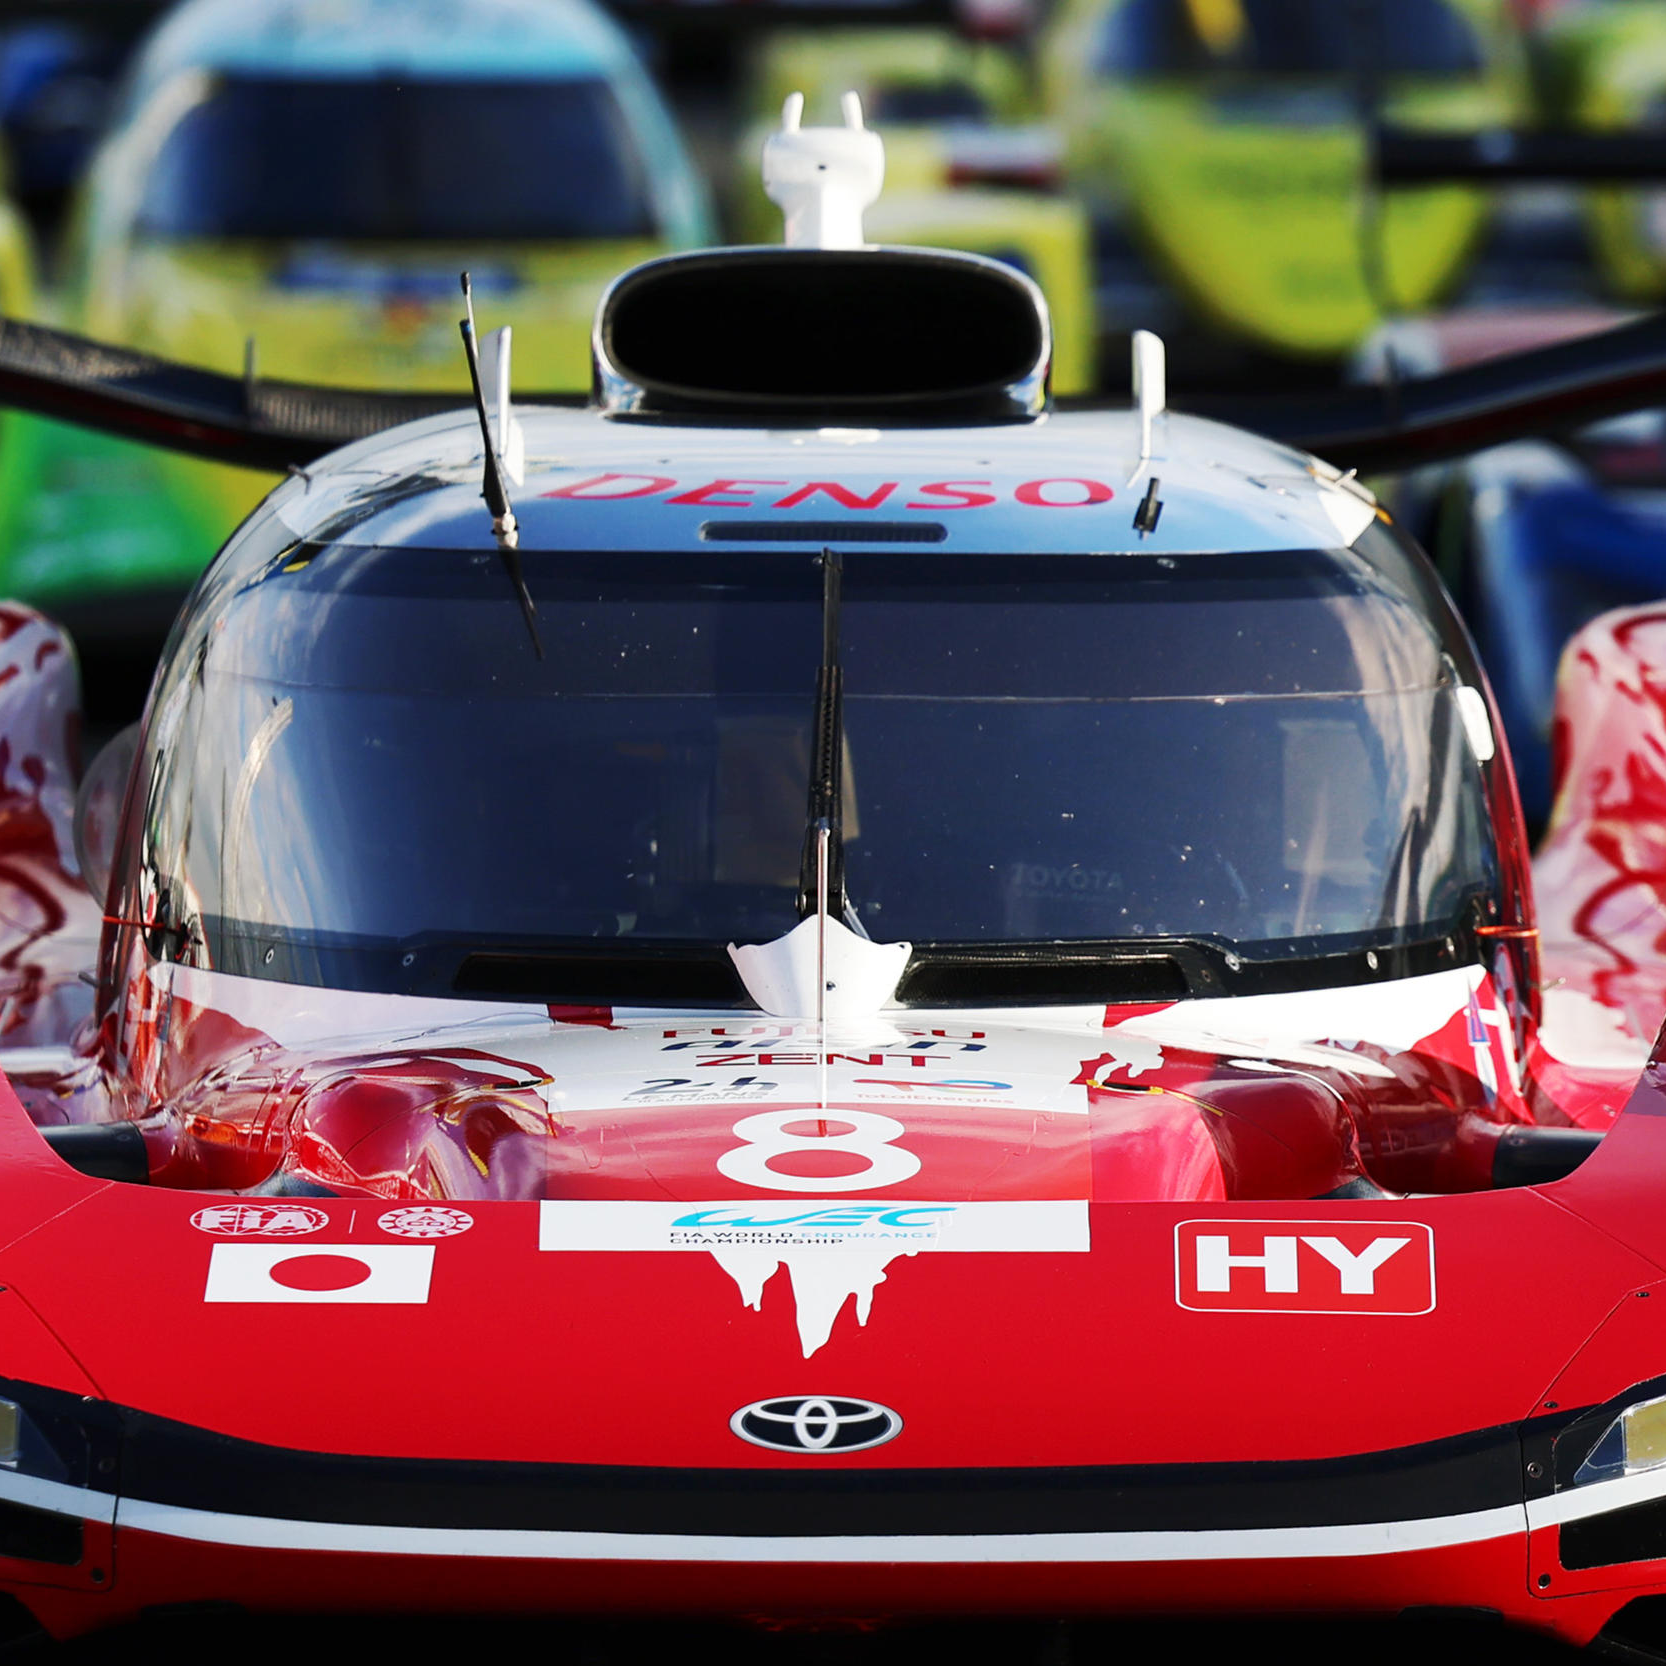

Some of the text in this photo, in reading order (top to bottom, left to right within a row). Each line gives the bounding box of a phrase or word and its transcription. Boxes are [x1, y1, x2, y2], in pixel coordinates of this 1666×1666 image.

[537, 473, 1114, 510] DENSO
[695, 1053, 951, 1067] ZENT
[716, 1108, 923, 1192] 8
[1196, 1235, 1412, 1295] HY
